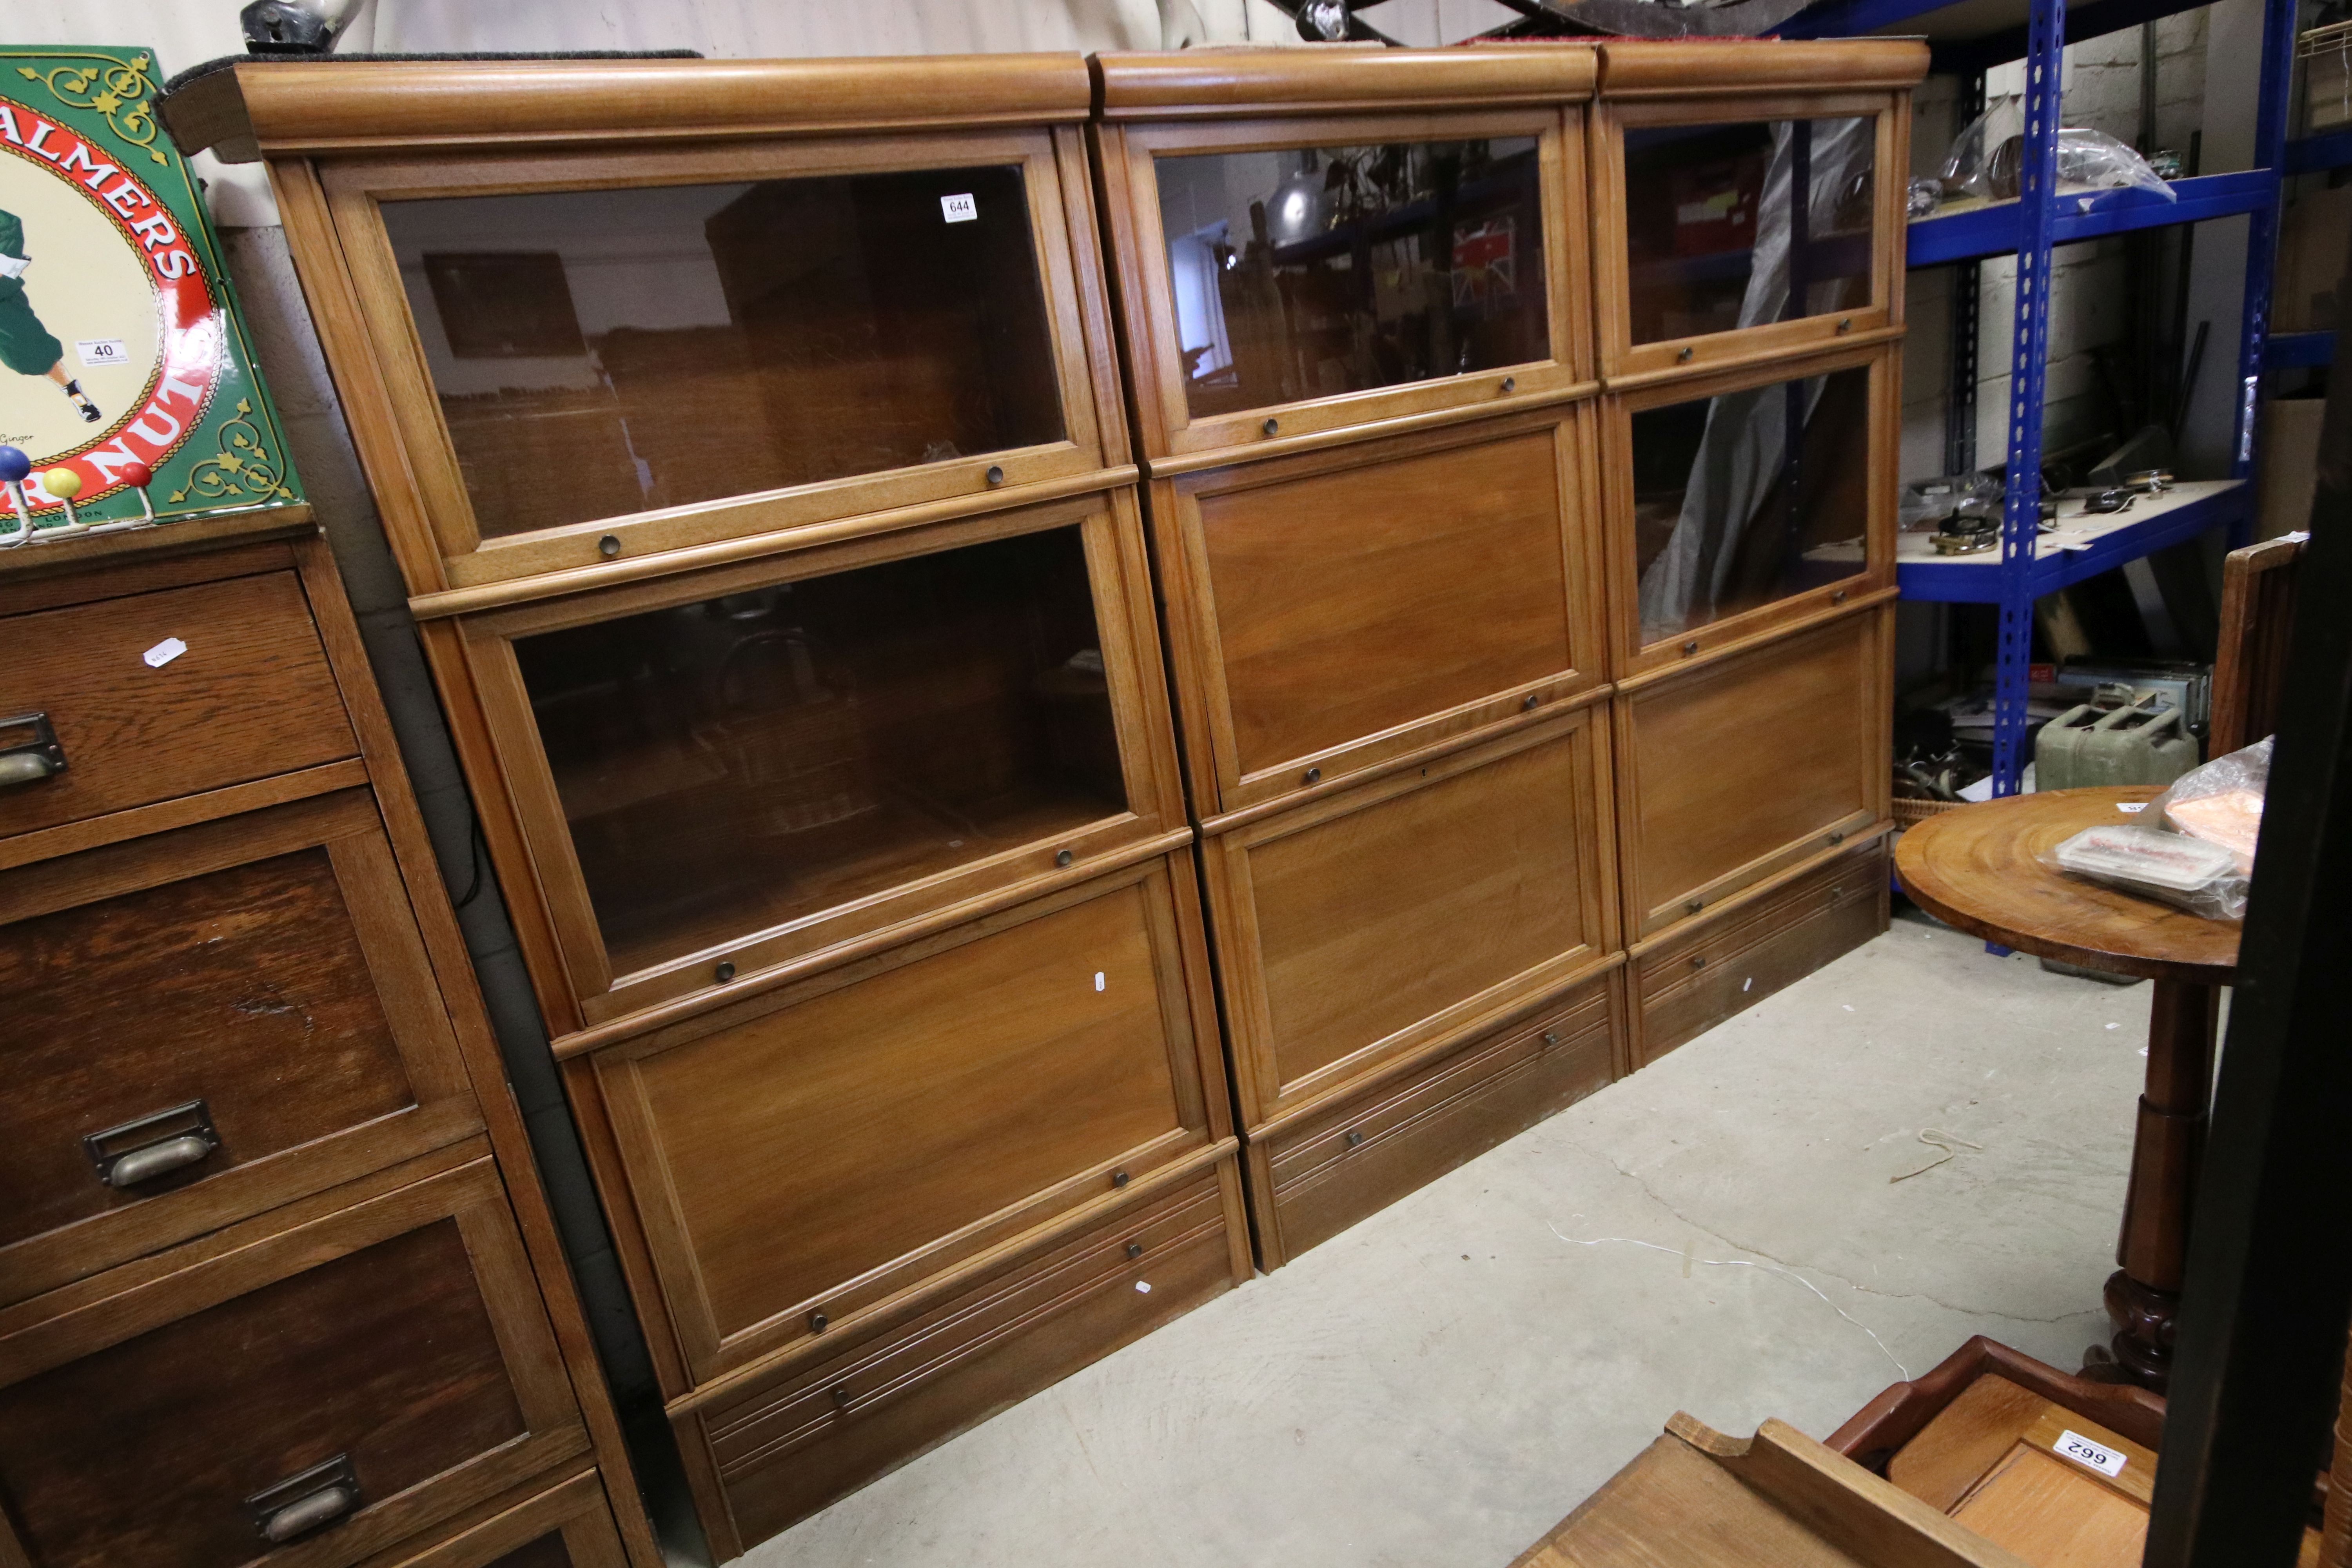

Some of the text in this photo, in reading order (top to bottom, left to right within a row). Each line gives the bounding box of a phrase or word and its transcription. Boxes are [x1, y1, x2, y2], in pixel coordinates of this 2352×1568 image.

[950, 200, 969, 212] 644
[95, 345, 113, 356] 40
[82, 328, 214, 484] NUTS
[2068, 1441, 2107, 1464] 662
